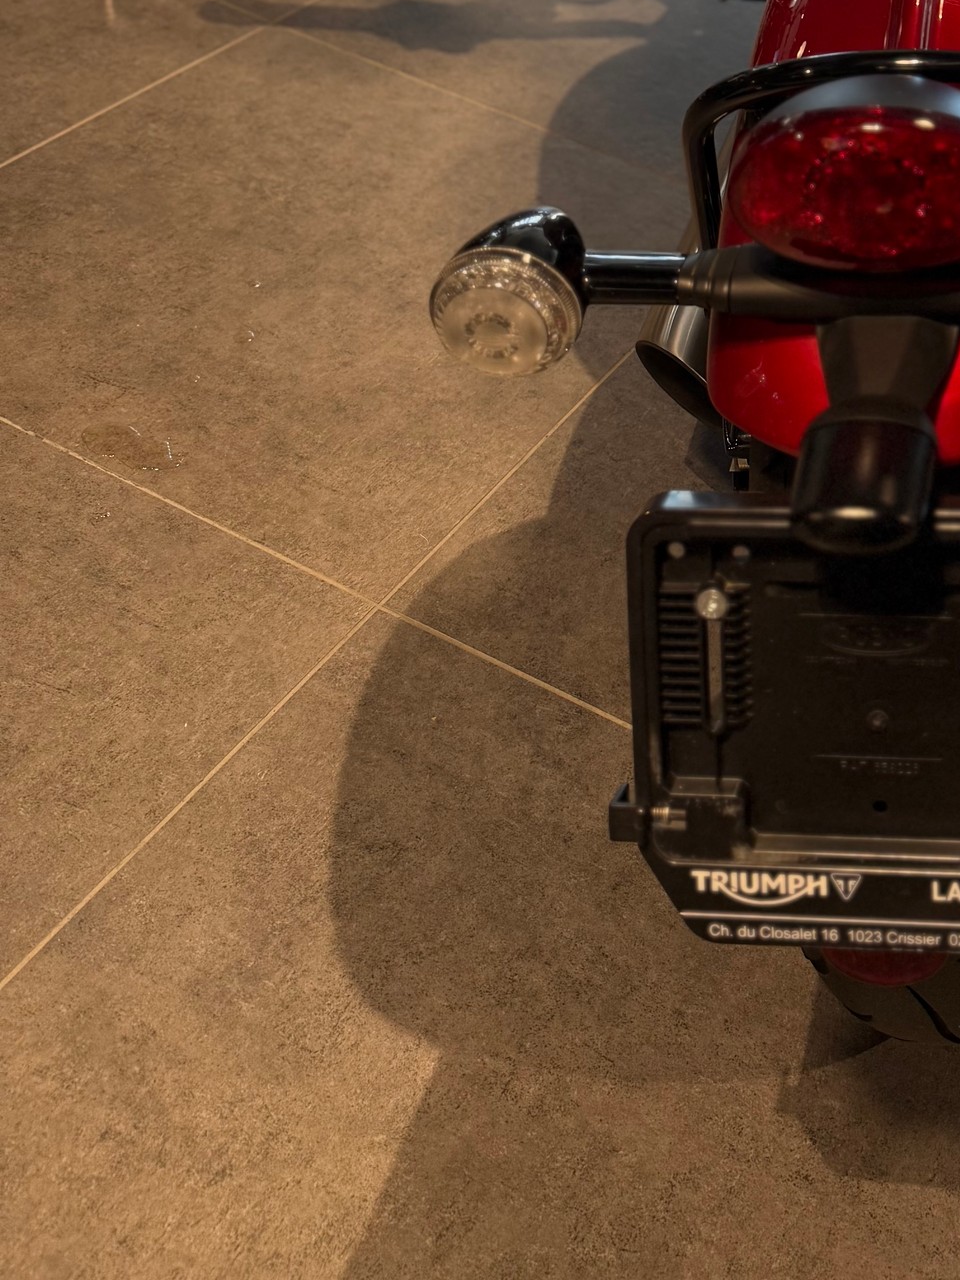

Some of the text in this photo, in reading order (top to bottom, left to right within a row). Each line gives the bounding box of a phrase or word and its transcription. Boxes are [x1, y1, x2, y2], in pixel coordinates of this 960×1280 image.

[691, 870, 829, 905] TRIUMPH
[709, 924, 733, 938] Ch.
[737, 926, 756, 938] du
[759, 926, 817, 941] Closalet
[822, 929, 839, 942] 16
[848, 931, 883, 943] 1023
[886, 932, 941, 946] Crissier
